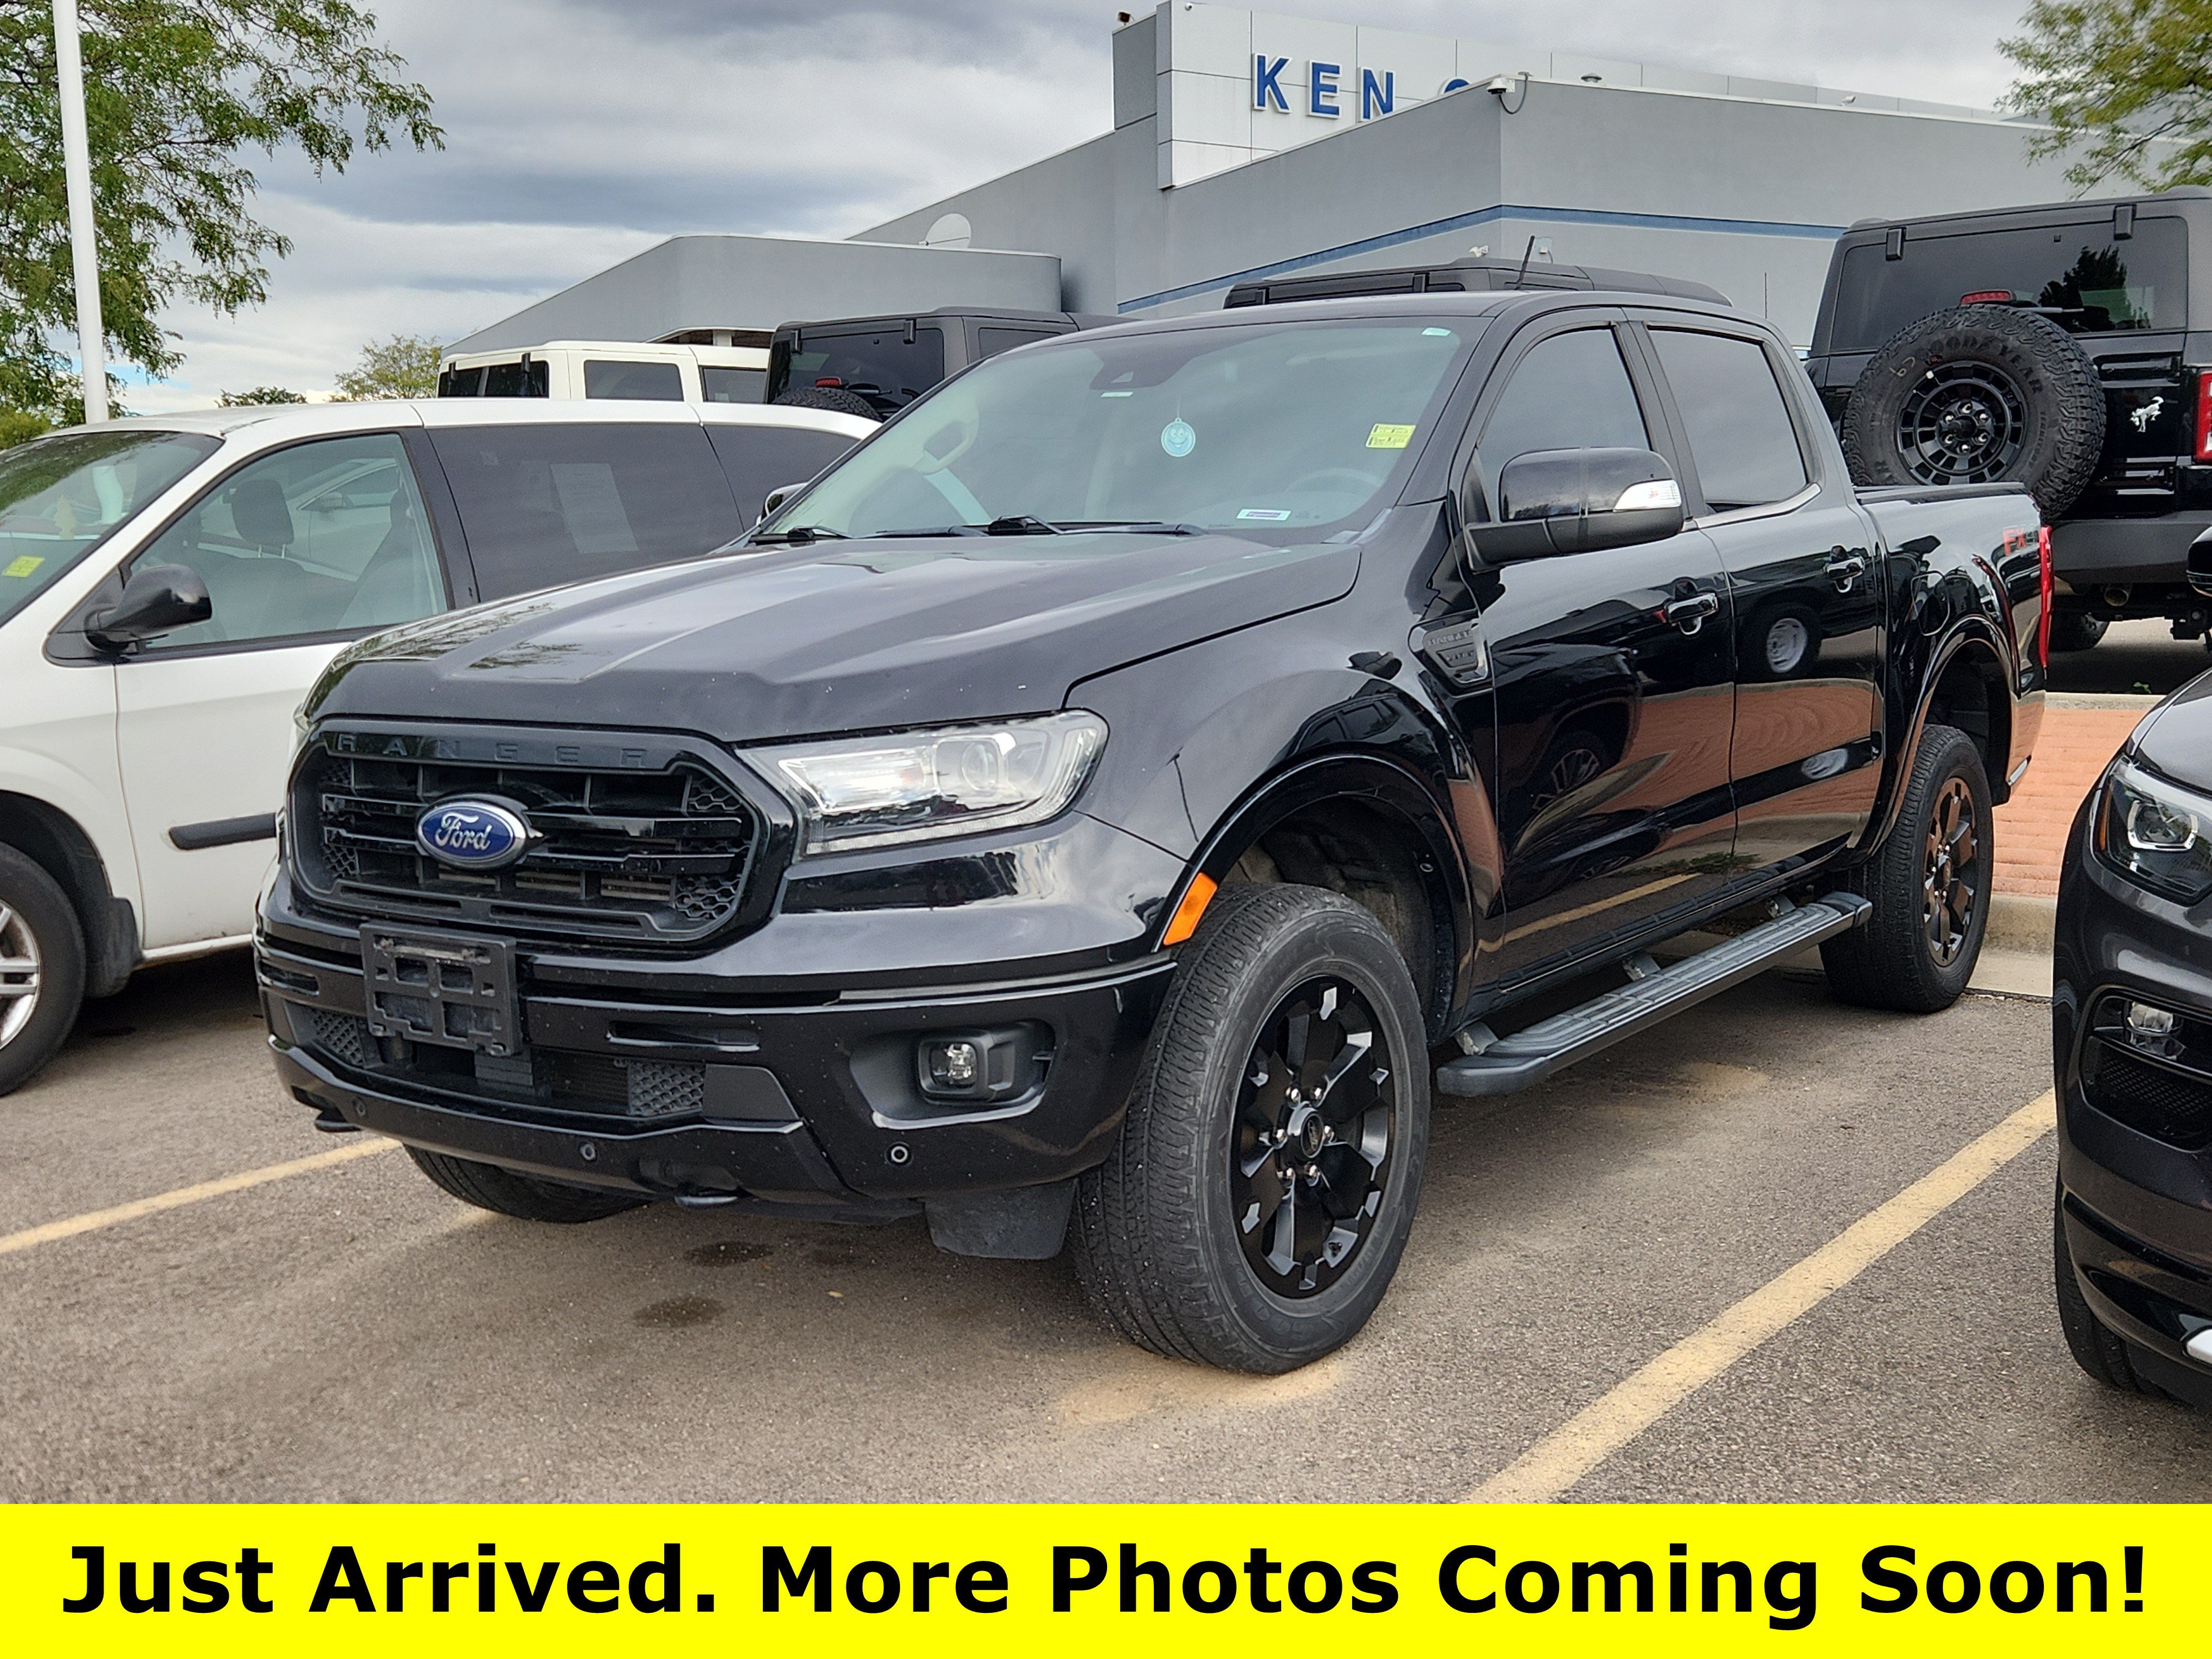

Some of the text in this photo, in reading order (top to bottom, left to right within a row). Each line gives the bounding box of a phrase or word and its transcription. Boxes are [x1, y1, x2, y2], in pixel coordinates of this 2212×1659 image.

[1252, 53, 1396, 122] KEN
[337, 733, 648, 768] RANGER
[434, 813, 492, 851] Ford
